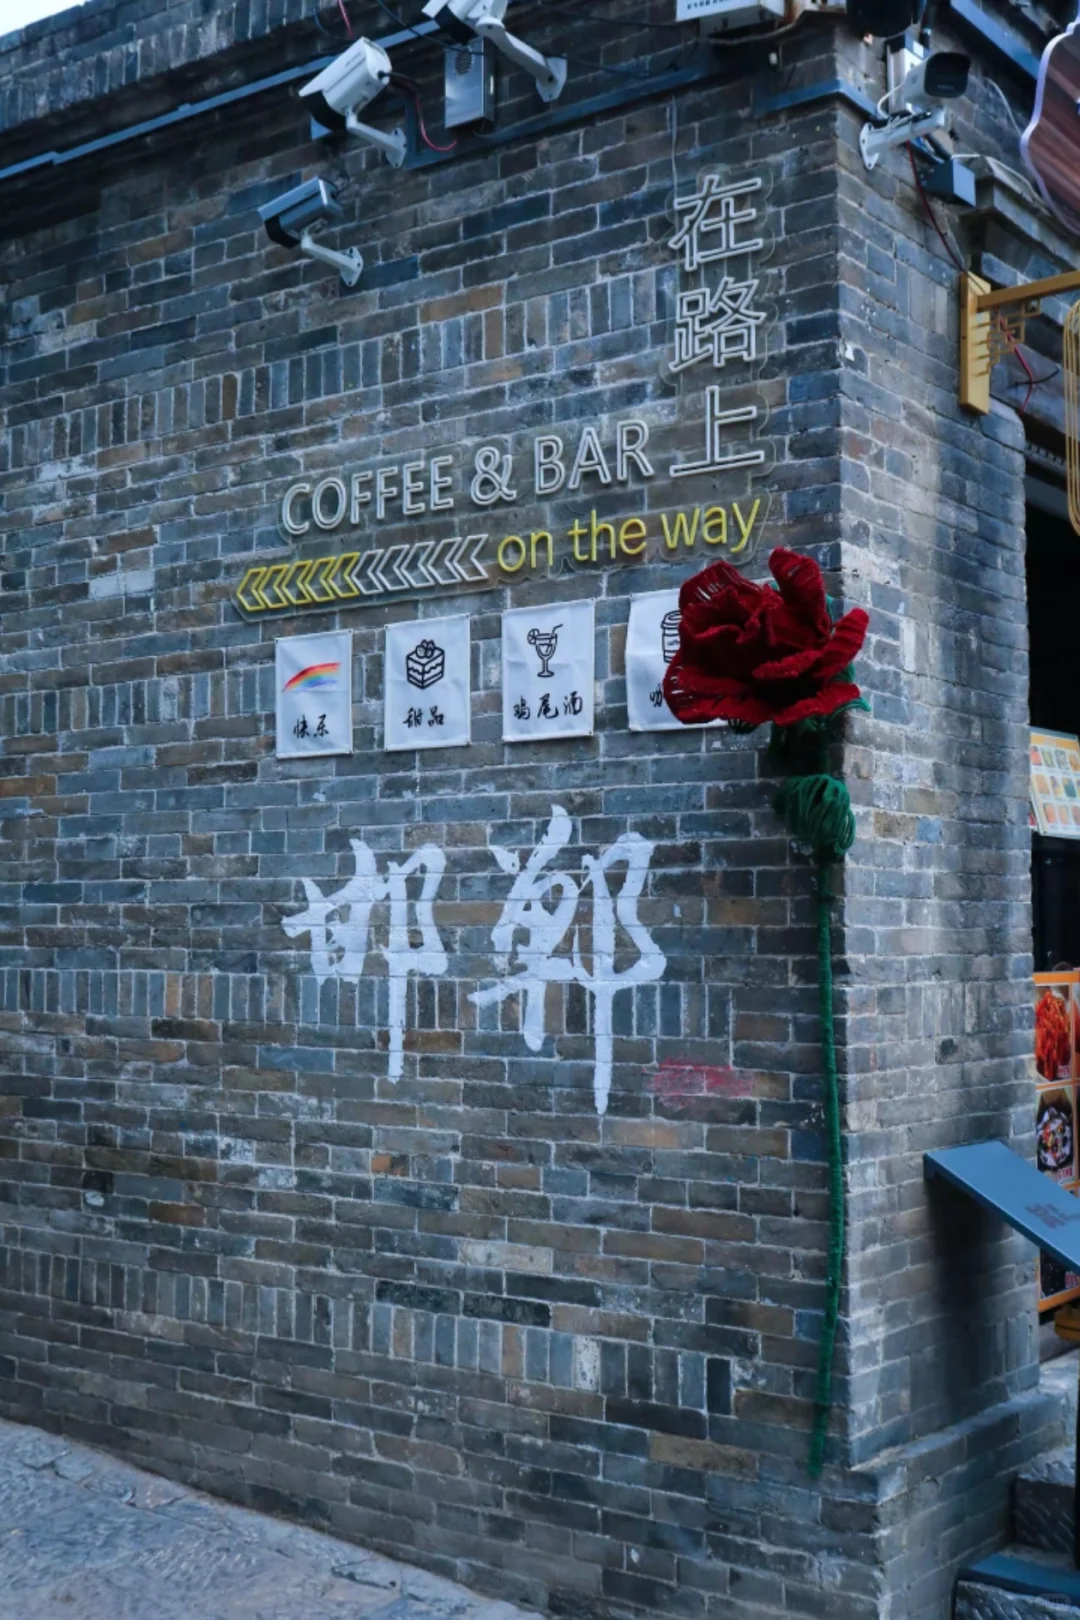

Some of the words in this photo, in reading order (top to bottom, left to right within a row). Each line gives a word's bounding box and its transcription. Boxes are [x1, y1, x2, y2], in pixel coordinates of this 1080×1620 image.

[668, 173, 766, 478] 在路上
[281, 456, 455, 535] COFFEE
[470, 446, 517, 504] &
[534, 420, 655, 494] BAR
[497, 530, 554, 572] on
[568, 509, 648, 563] the
[661, 498, 761, 553] way
[402, 705, 445, 729] 甜品
[512, 690, 583, 720] 鸡尾酒
